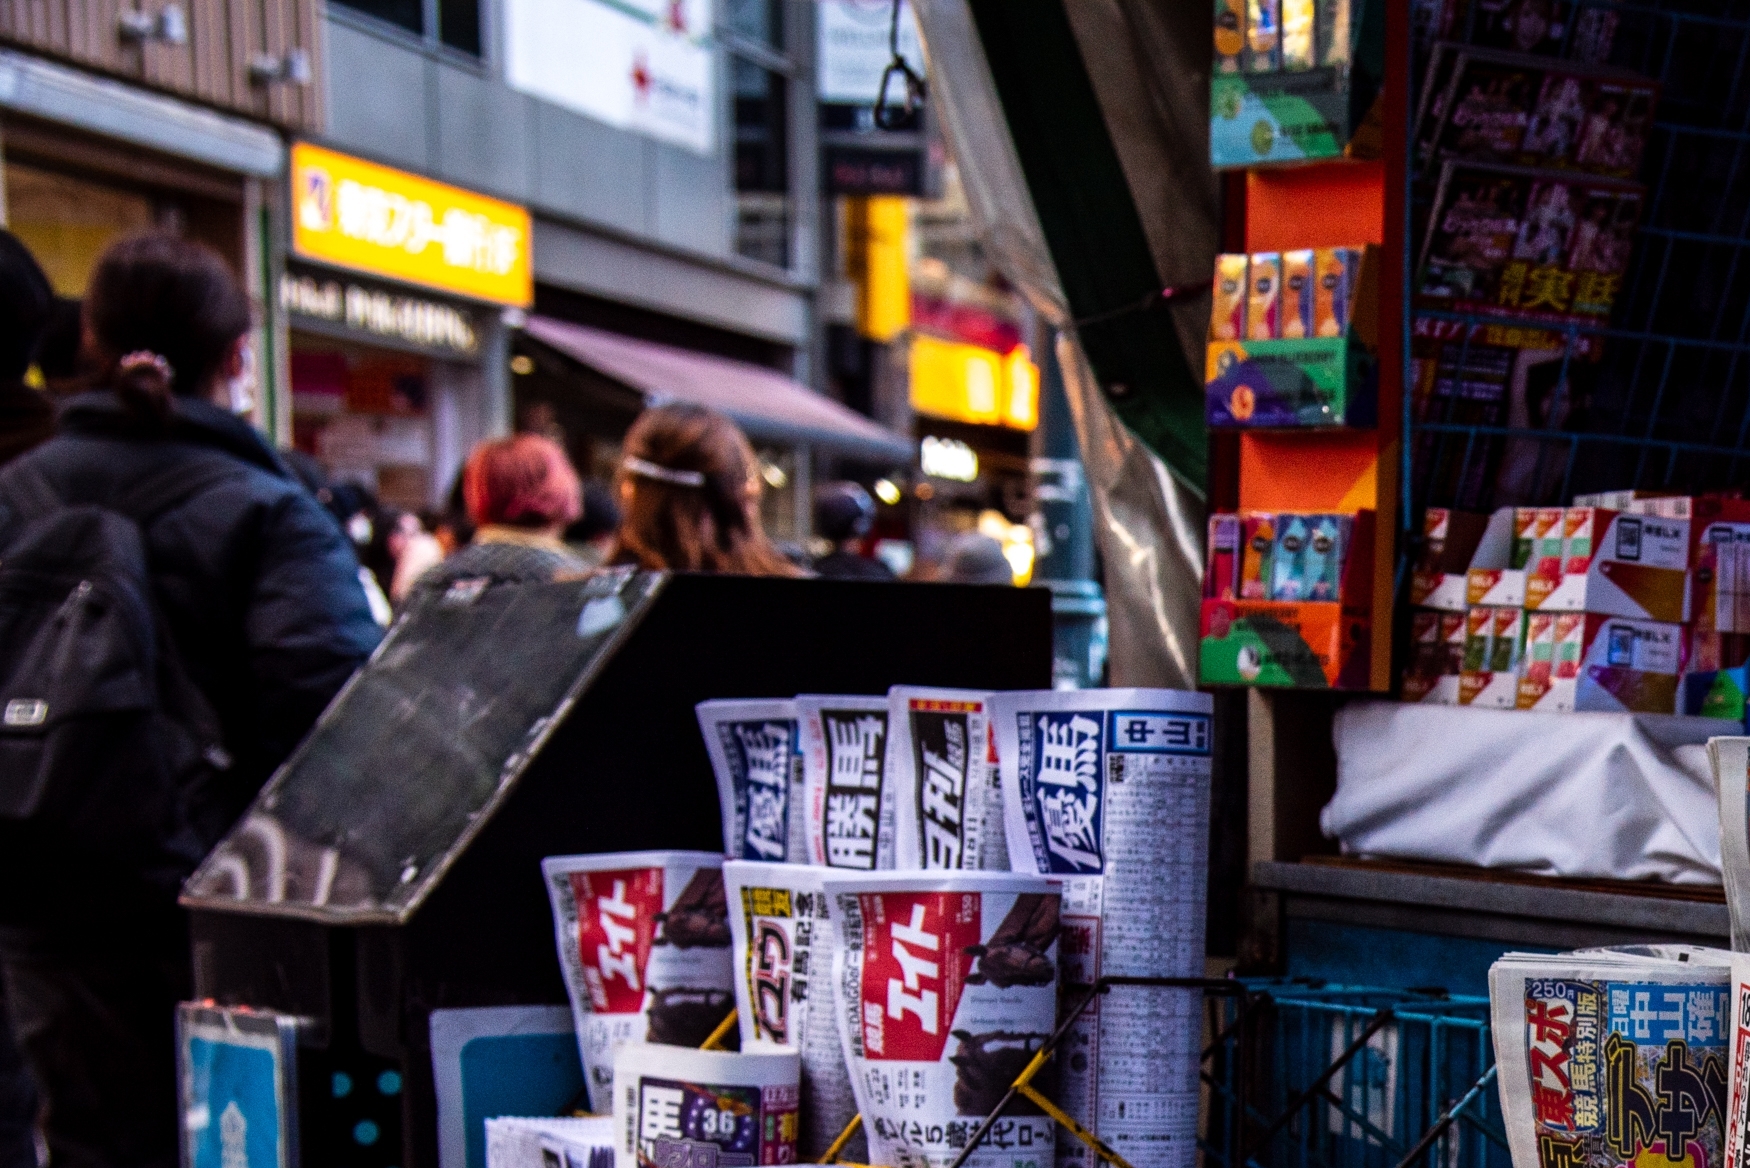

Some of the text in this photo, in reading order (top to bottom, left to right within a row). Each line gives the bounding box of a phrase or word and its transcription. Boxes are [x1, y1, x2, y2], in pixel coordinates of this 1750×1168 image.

[827, 708, 886, 868] 勝馬
[1037, 716, 1101, 873] 優馬
[593, 880, 642, 996] エイト
[793, 890, 815, 1003] 有馬記念
[886, 902, 942, 1036] エイト
[1532, 980, 1576, 1000] 250円
[1532, 995, 1575, 1132] 東スポ
[1574, 990, 1600, 1132] 競馬特別版
[1611, 988, 1630, 1034] 日曜
